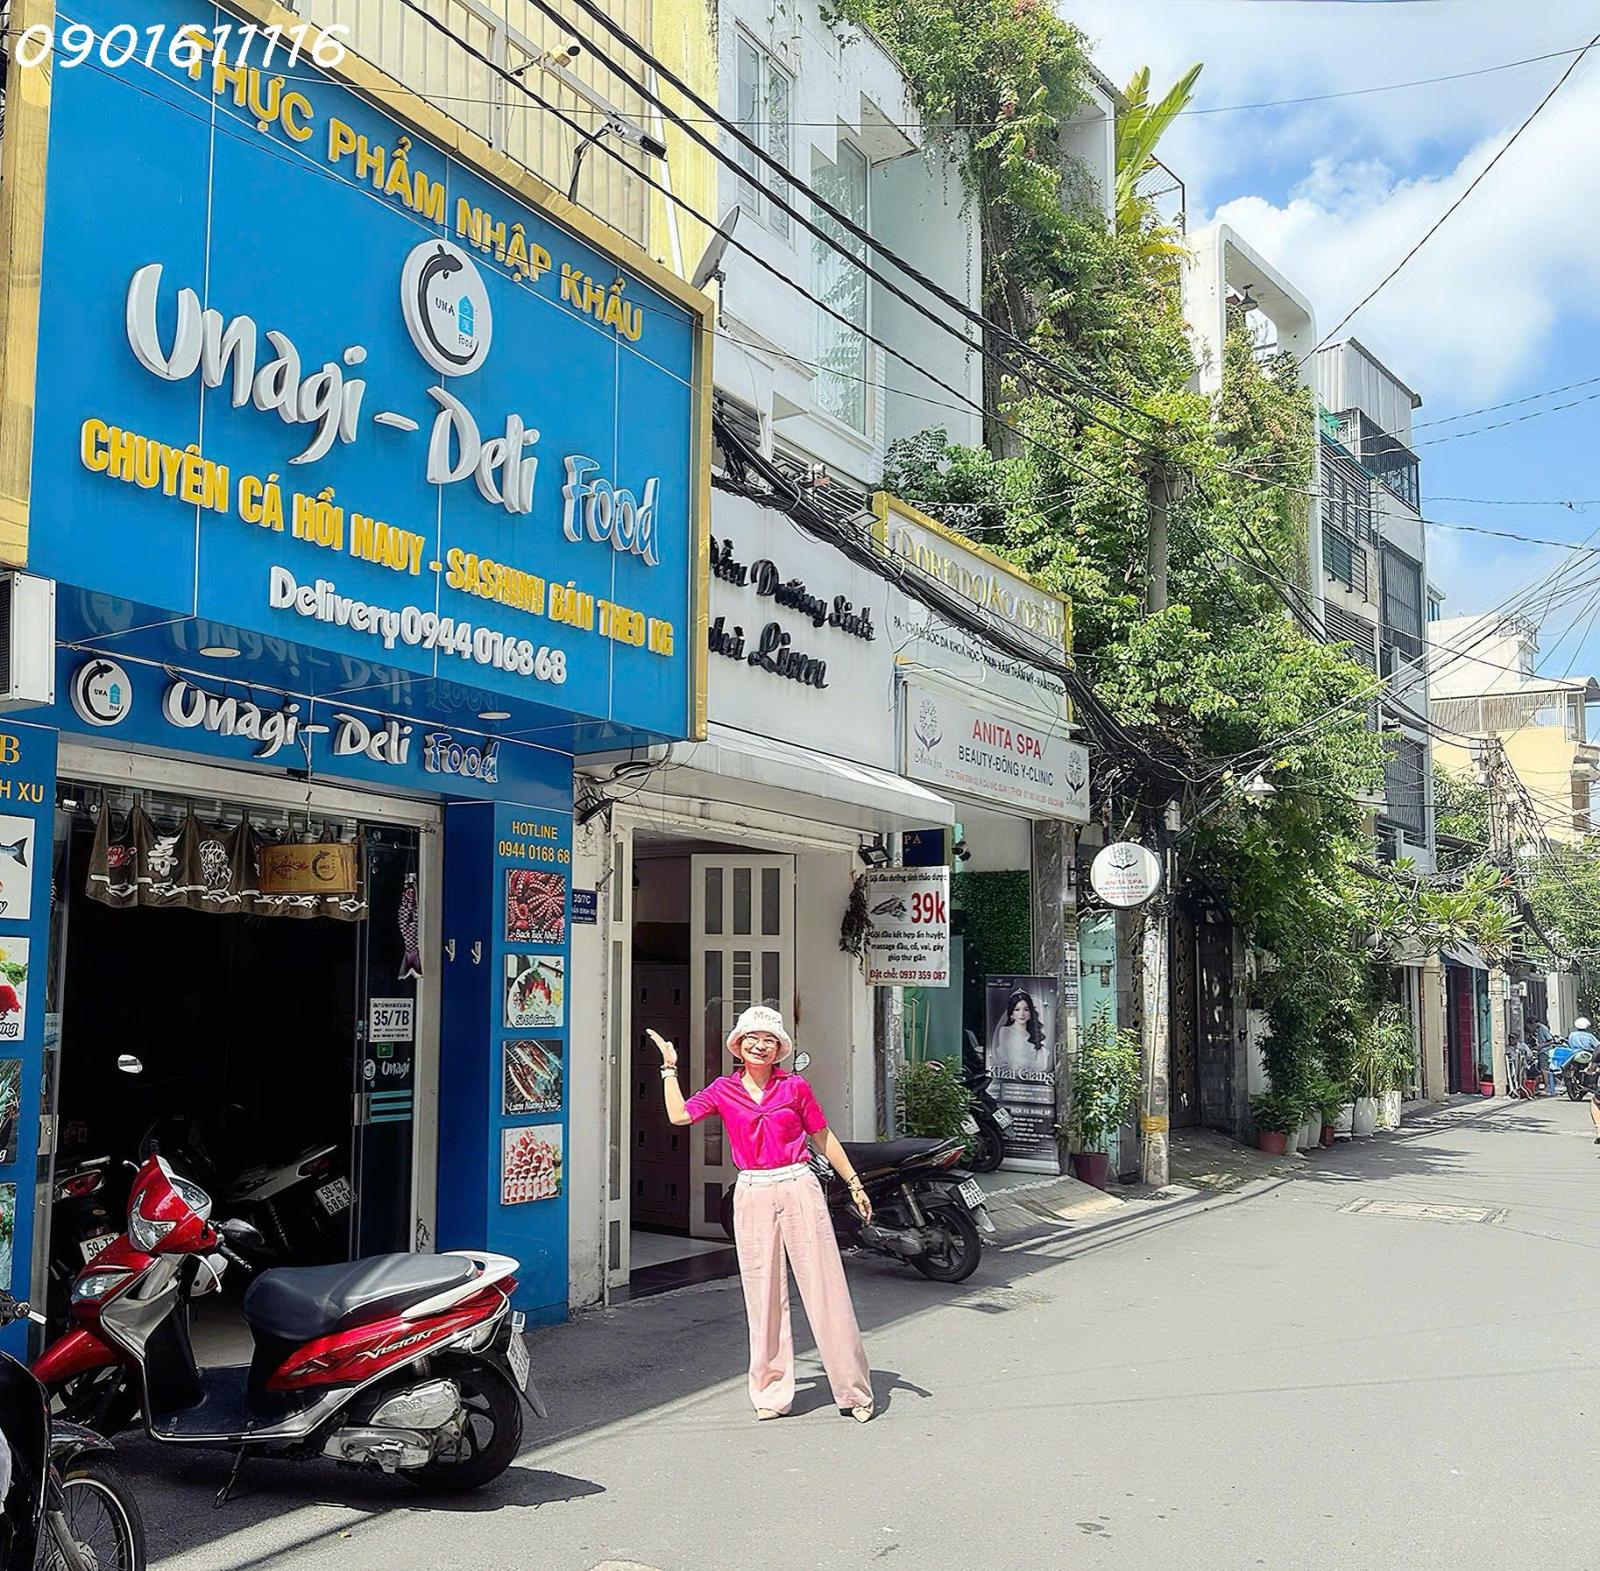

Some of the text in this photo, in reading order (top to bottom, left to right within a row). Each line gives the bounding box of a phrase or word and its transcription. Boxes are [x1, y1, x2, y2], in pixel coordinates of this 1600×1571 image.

[177, 24, 643, 342] THỰC PHẨM NHẬP KHẨU
[126, 262, 367, 465] Unagi
[426, 385, 541, 515] Deli
[562, 454, 661, 567] Food
[81, 418, 230, 513] CHUYÊN
[238, 473, 285, 532] CÁ
[291, 486, 344, 551] HỒI
[349, 513, 425, 576] NAUY
[446, 548, 545, 615] SASHIMI
[548, 581, 594, 631] BÁN
[597, 599, 647, 647] THEO
[648, 617, 675, 657] KG
[751, 559, 828, 628] Dưỡng
[828, 595, 877, 642] Sinh
[163, 681, 300, 758] Unagi
[332, 713, 413, 765] Deli
[424, 731, 500, 783] Food
[972, 719, 1042, 760] ANITA SPA
[0, 735, 21, 764] B
[17, 782, 44, 803] XU
[512, 821, 558, 840] HOTLINE
[499, 840, 571, 864] 0944 0168 68
[911, 891, 947, 924] 39k
[871, 944, 895, 952] massage
[869, 968, 882, 979] Đặt
[900, 970, 916, 980] 0937
[918, 970, 932, 980] 359
[933, 970, 947, 981] 087
[374, 1010, 409, 1026] 35/7B
[381, 1057, 410, 1080] Unagi
[362, 1326, 441, 1360] VISION
